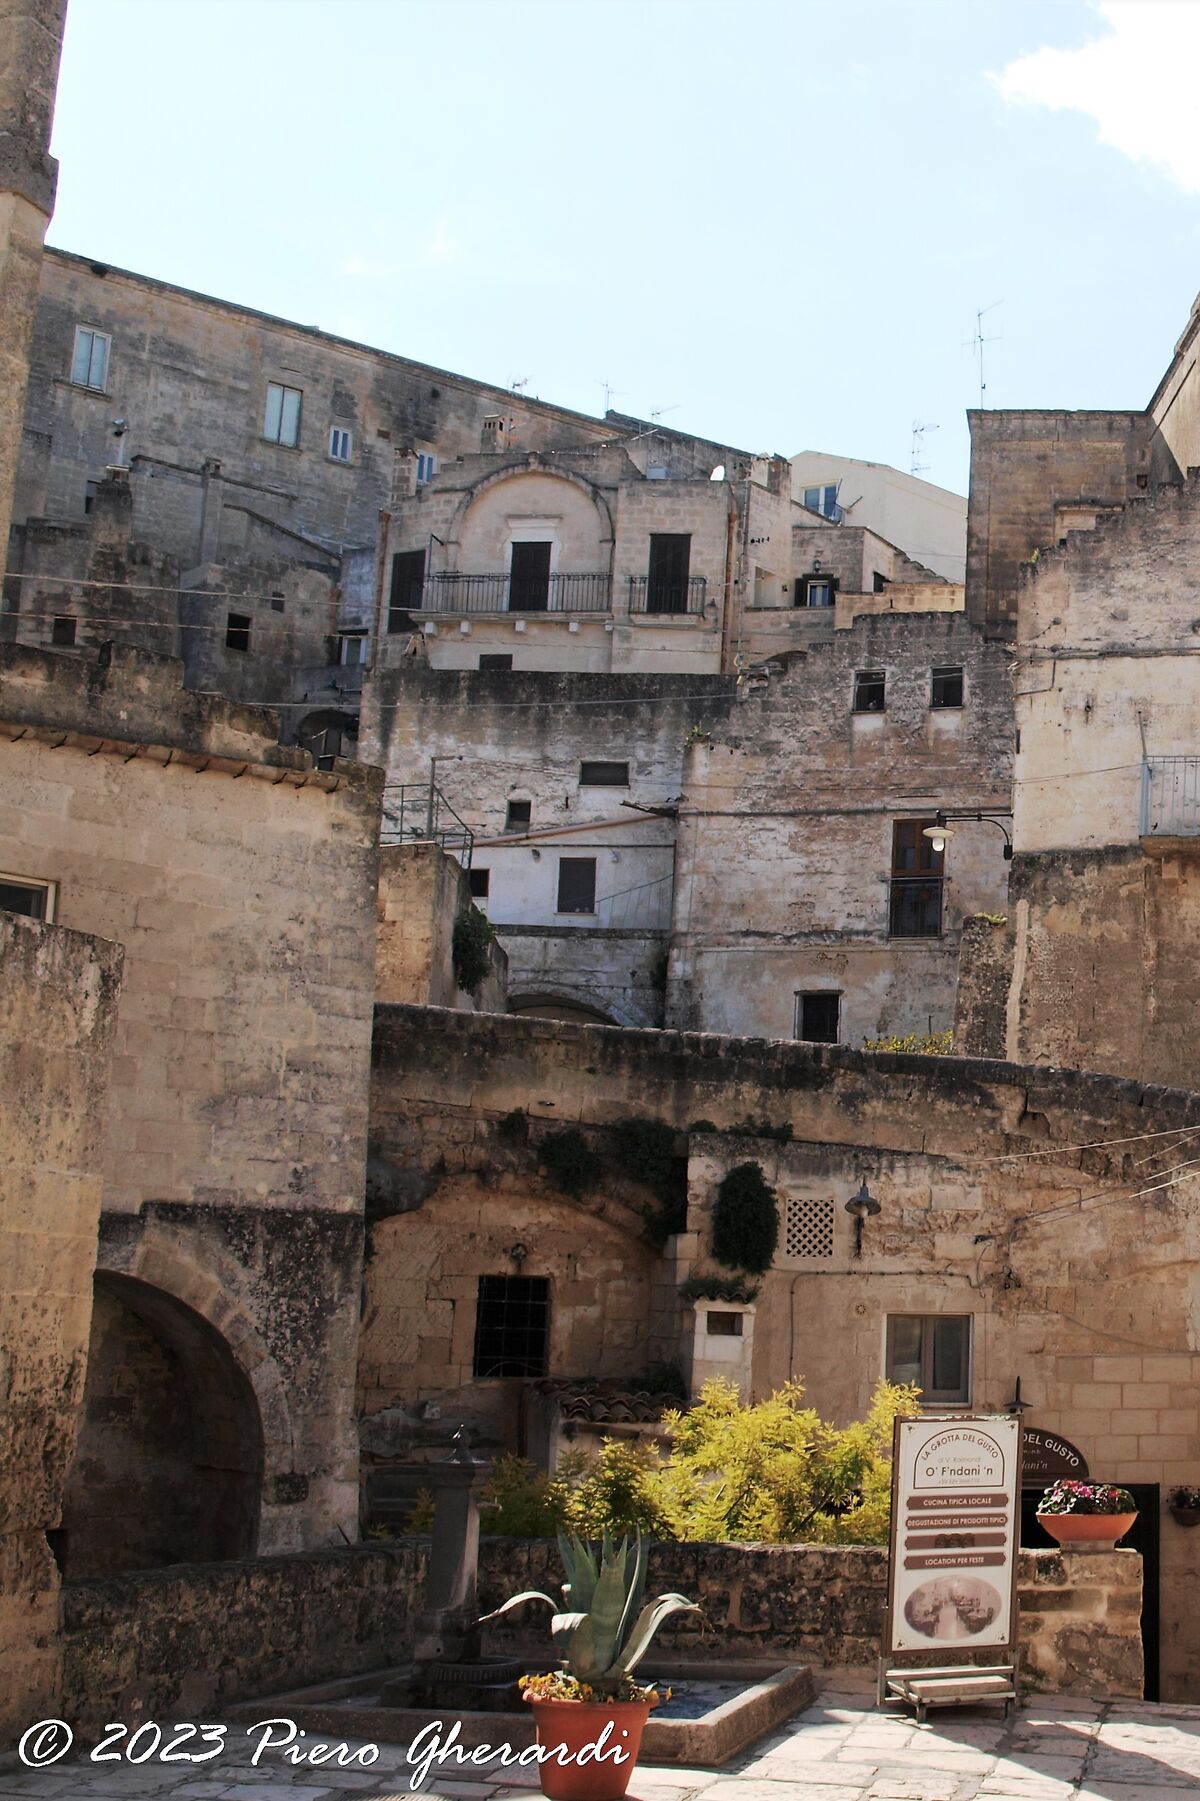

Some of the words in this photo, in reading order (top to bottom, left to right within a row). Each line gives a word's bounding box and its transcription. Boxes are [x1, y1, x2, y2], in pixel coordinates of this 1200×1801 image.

[922, 1451, 930, 1460] LA
[931, 1434, 960, 1451] GROTTA
[962, 1434, 975, 1443] DEL
[977, 1438, 998, 1458] GUSTO
[1045, 1439, 1079, 1466] GUSTO
[907, 1518, 951, 1526] DEGUSTAZIONE
